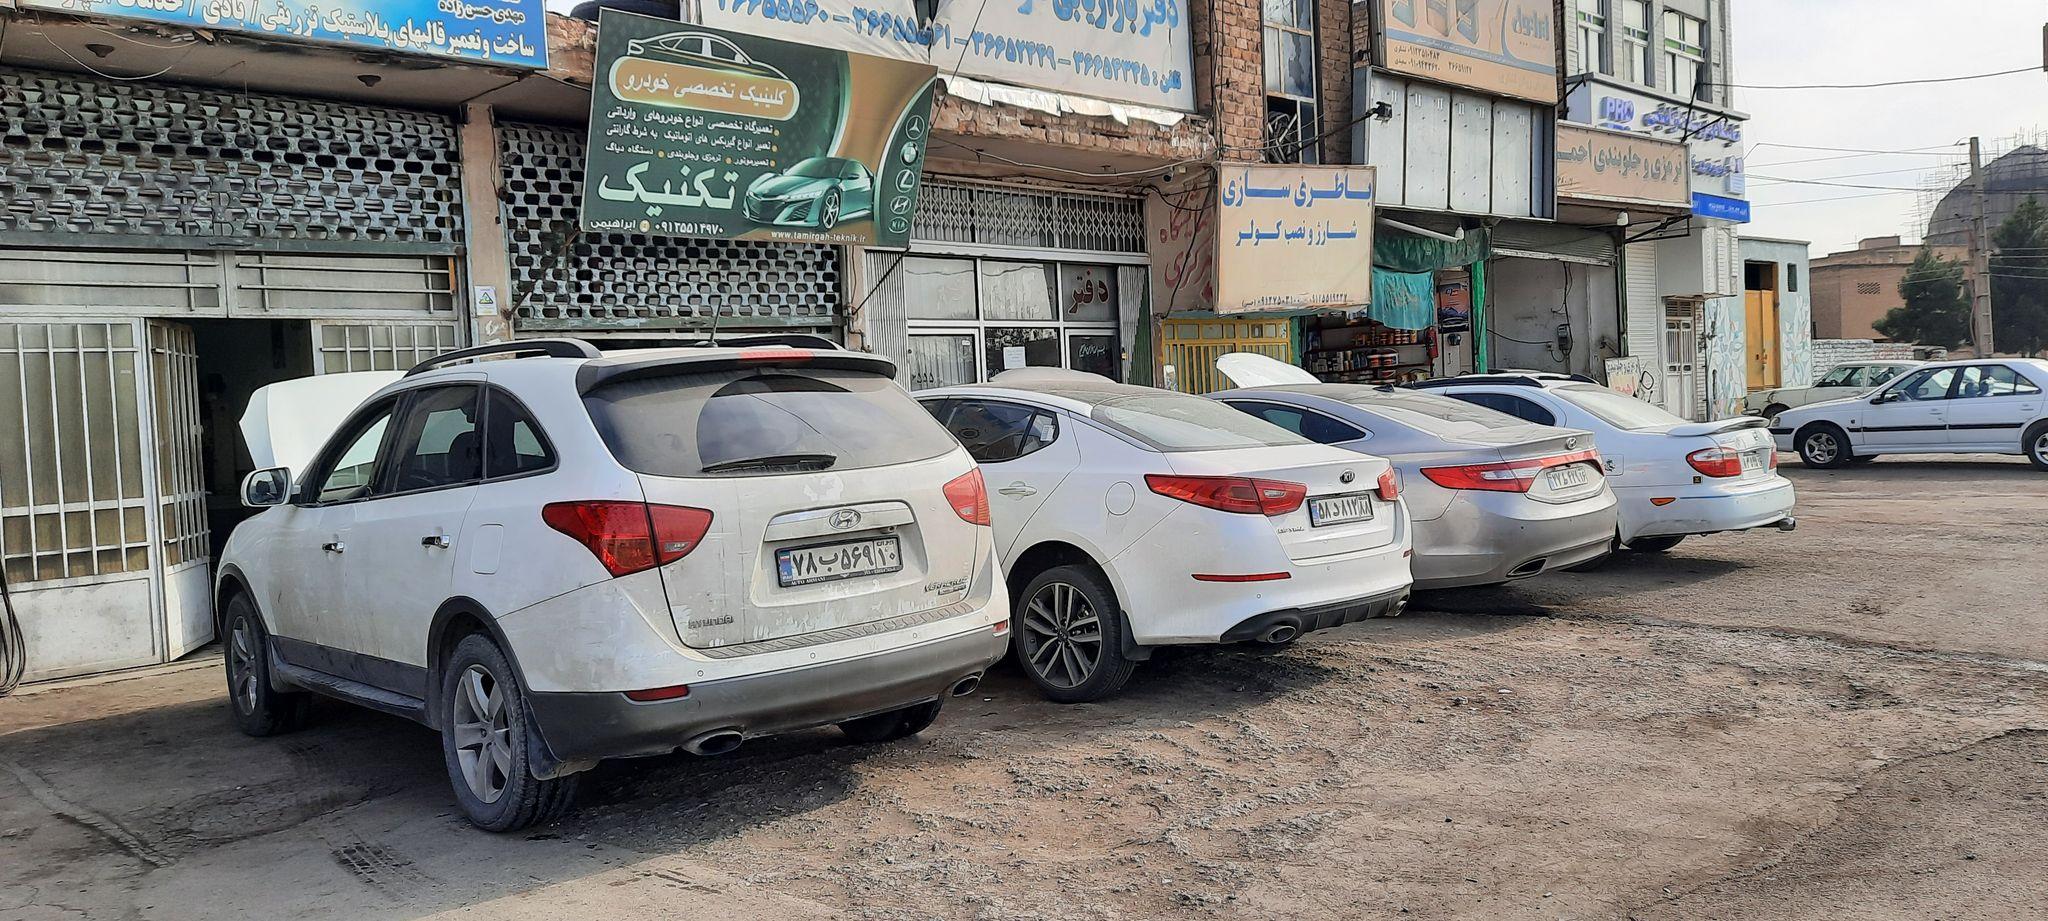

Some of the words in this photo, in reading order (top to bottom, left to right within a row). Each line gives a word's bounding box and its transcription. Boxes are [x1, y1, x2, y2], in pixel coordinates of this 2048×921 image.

[202, 0, 246, 27] بادی
[260, 0, 319, 37] تزریقی
[493, 8, 526, 25] مهدی
[322, 8, 391, 48] پلاستیک
[393, 18, 446, 51] قالبهای
[493, 34, 536, 58] ساخت
[623, 73, 670, 94] خودرو
[674, 80, 736, 98] تخصصی
[739, 87, 787, 109] کلینیک
[607, 106, 637, 121] وارداتی
[643, 109, 684, 125] خودروهای
[684, 115, 704, 130] انواع
[707, 119, 743, 132] تخصصی
[744, 119, 773, 136] تعمیرگاه
[627, 146, 654, 155] دستگاه
[1594, 143, 1642, 177] جلوبندی
[598, 161, 740, 217] تکنیک
[1222, 169, 1292, 207] سازی
[589, 218, 637, 233] ابراهیمی
[771, 230, 867, 243] www.tamirgah-teknik.ir
[1235, 218, 1283, 247] کولر
[1284, 219, 1306, 246] نصب
[1316, 219, 1359, 246] شارژ
[1067, 269, 1110, 315] دفتر
